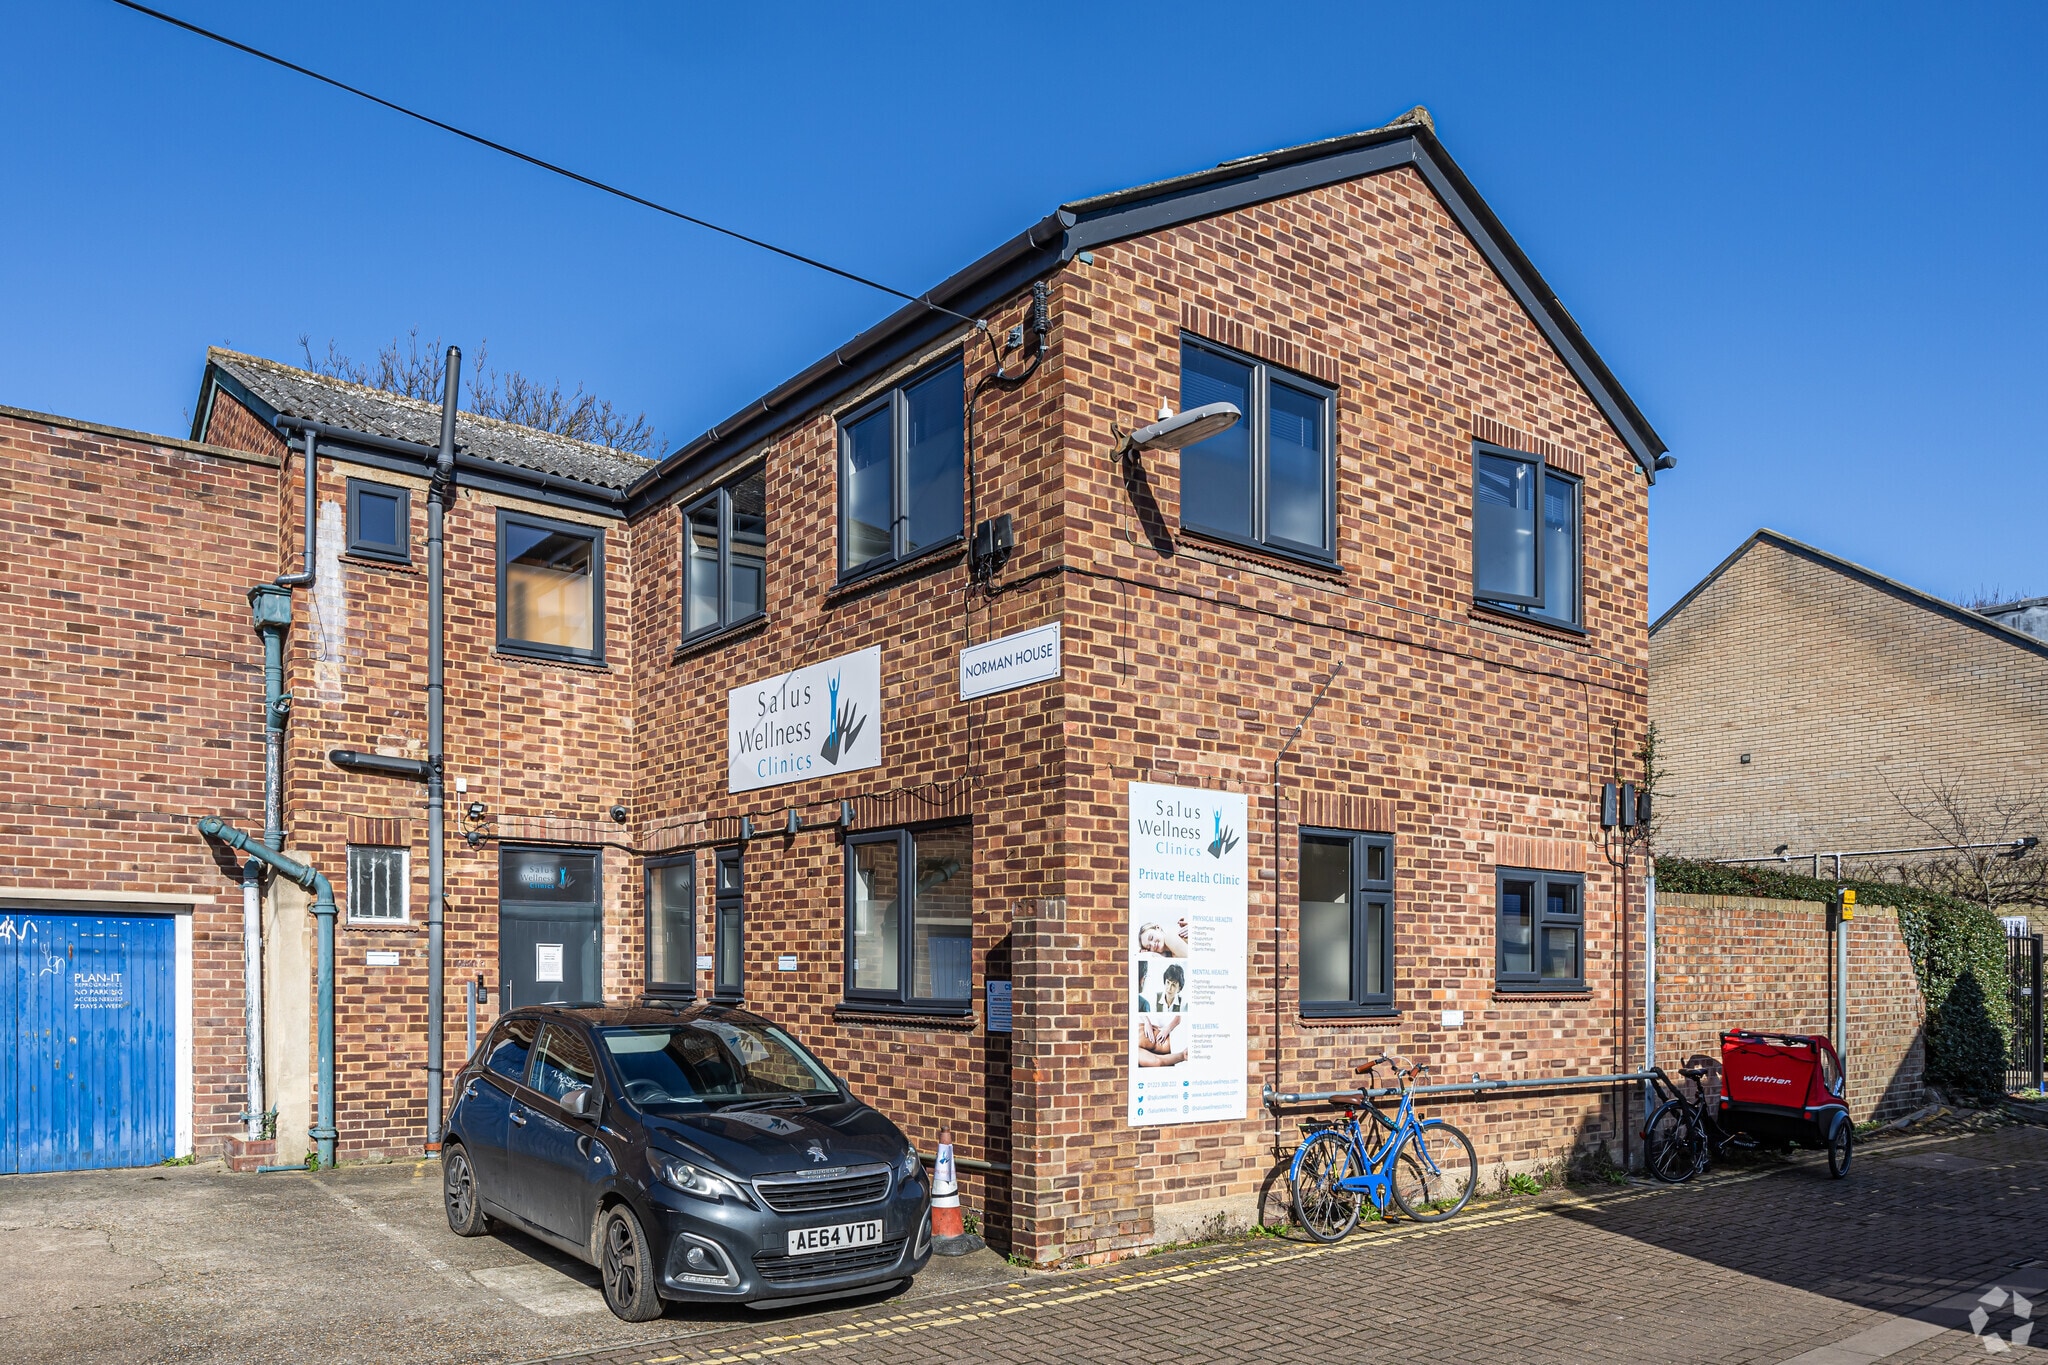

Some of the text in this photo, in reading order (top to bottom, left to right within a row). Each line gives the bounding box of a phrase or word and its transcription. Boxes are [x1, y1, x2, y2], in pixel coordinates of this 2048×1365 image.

[966, 643, 1053, 679] NORMAN HOUSE
[757, 683, 811, 717] Salus
[738, 720, 811, 754] Wellness
[757, 753, 812, 778] Clinics
[1156, 800, 1201, 820] Salus
[1138, 819, 1201, 840] Wellness
[1156, 841, 1201, 857] Clinics
[520, 873, 555, 882] Wellness
[529, 865, 555, 874] Salus
[1139, 868, 1240, 886] Private Health Clinic
[1138, 891, 1156, 899] Some
[1156, 892, 1162, 900] of
[74, 973, 122, 982] PLAN-IT
[1743, 1075, 1791, 1085] winther
[796, 1222, 876, 1249] AE64 VTD
